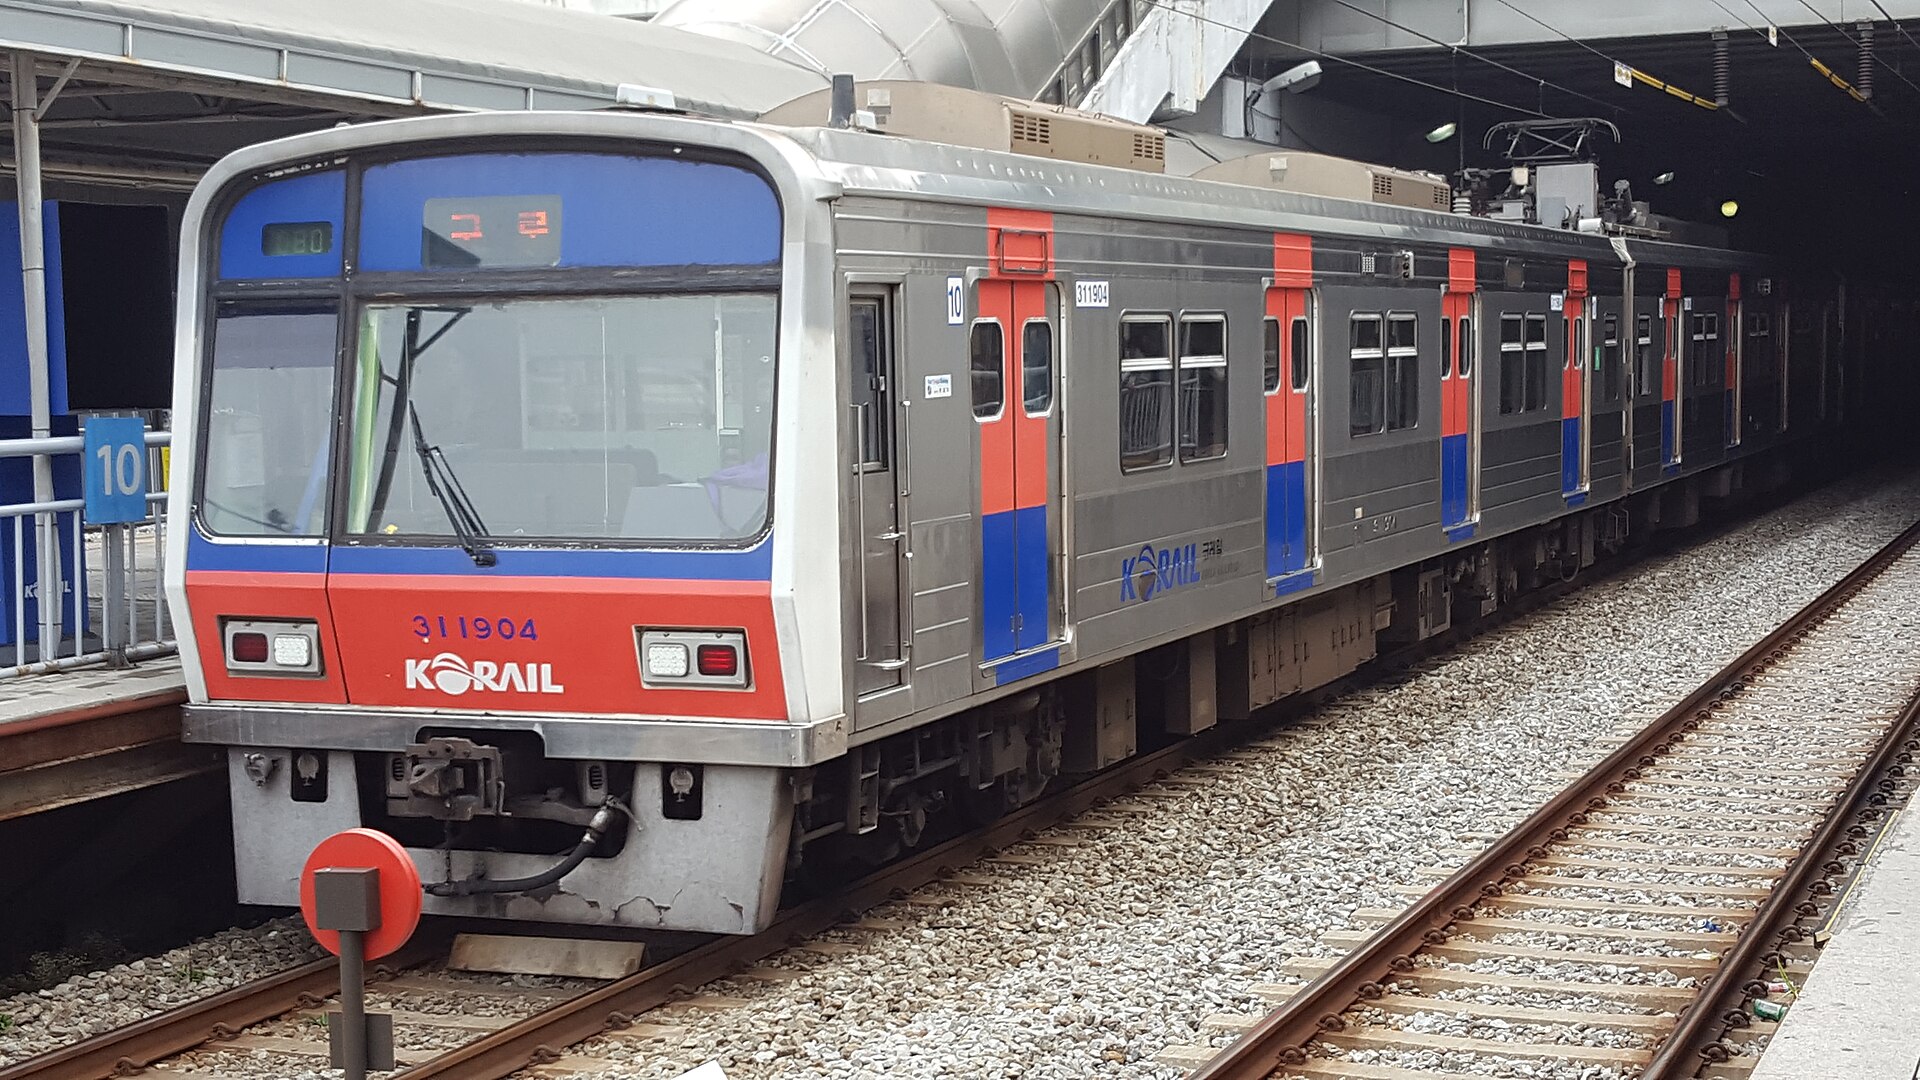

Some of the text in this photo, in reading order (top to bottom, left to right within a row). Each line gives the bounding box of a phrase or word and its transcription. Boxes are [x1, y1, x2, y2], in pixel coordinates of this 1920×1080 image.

[948, 285, 961, 317] 10
[1077, 284, 1108, 303] 311904
[97, 443, 141, 496] 10
[1120, 544, 1201, 602] KORAIL
[412, 615, 538, 641] 311904
[405, 652, 565, 695] KORAIL
